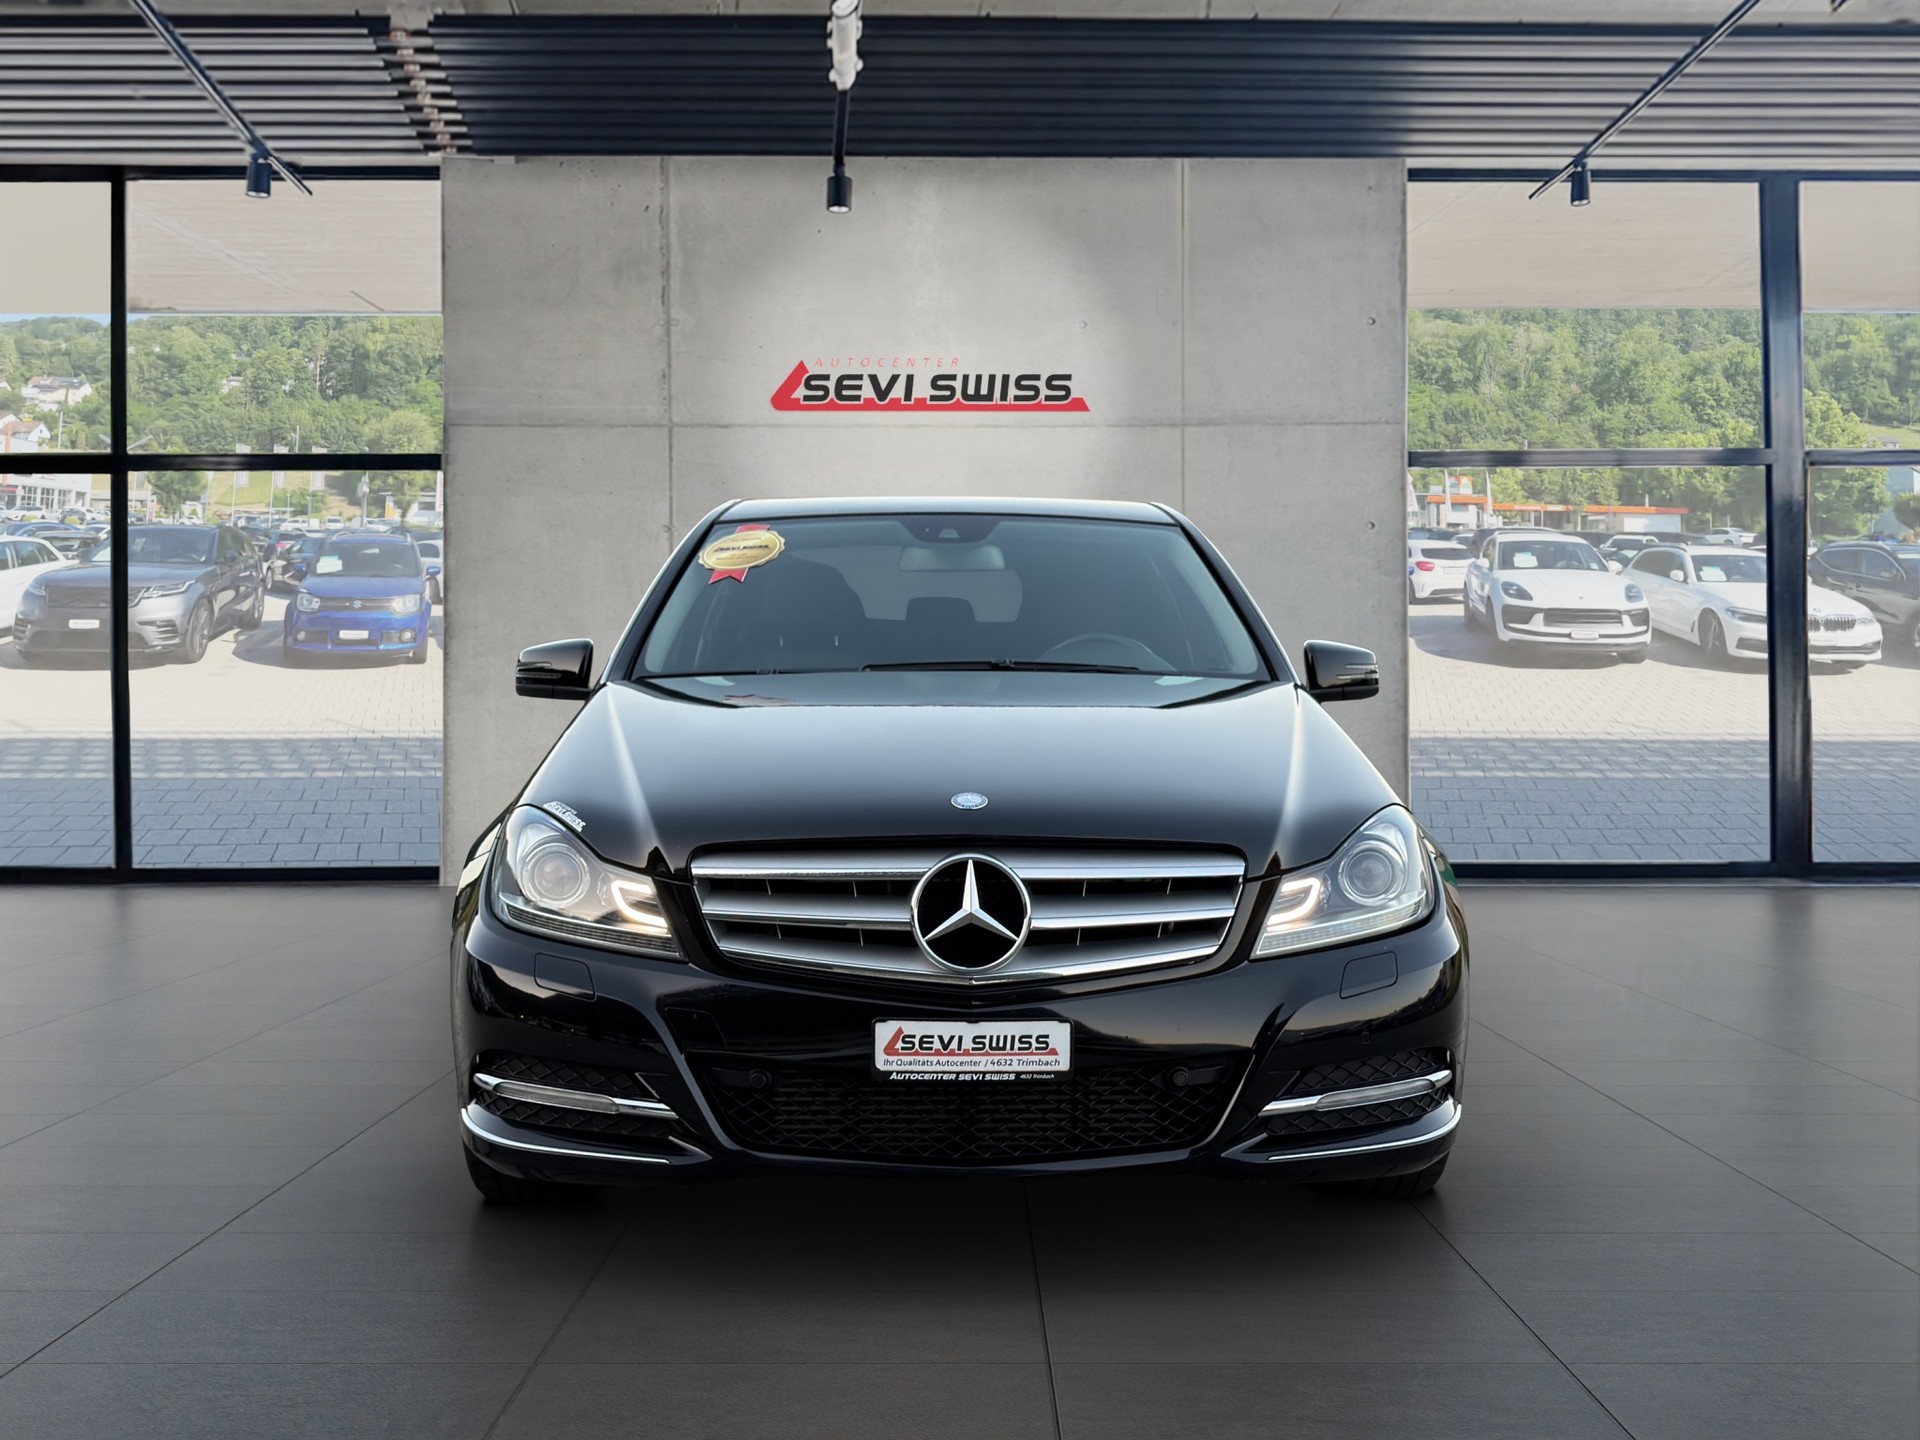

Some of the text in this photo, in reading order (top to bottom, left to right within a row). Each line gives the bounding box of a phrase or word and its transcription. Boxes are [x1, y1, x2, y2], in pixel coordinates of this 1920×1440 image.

[813, 357, 960, 368] AUTOCENTER
[802, 374, 1072, 402] SEVI SWISS
[900, 1034, 1050, 1052] SEVI SWISS
[883, 1058, 895, 1067] Ihr
[935, 1058, 982, 1067] Autocenter
[990, 1058, 1014, 1067] 4632
[1016, 1058, 1061, 1067] Trimbach
[889, 1072, 957, 1081] AUTOCENTER
[958, 1073, 983, 1081] SEVI
[984, 1073, 1016, 1081] SWISS
